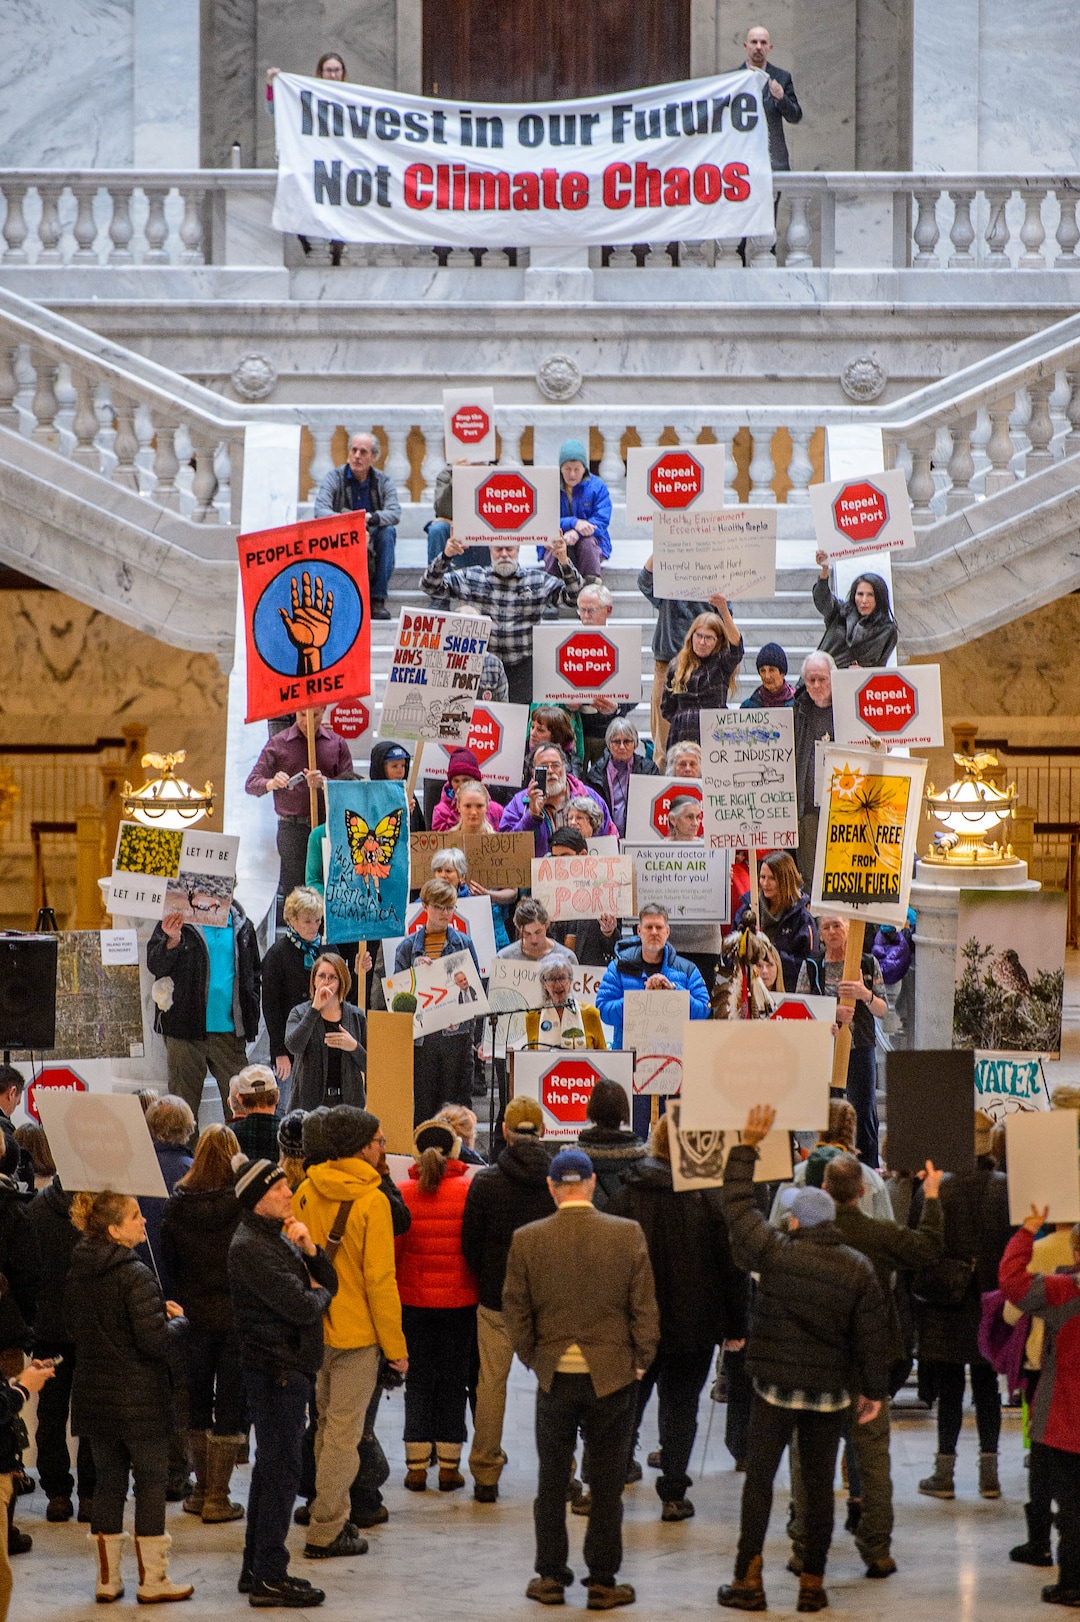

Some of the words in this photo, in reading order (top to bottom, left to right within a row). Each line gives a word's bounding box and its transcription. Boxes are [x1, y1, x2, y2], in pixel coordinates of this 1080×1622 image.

[300, 90, 448, 144] Invest
[459, 109, 504, 149] in
[518, 112, 600, 147] our
[612, 92, 759, 143] Future
[314, 159, 392, 208] Not
[404, 163, 589, 211] Climate
[603, 162, 750, 209] Chaos
[657, 465, 695, 479] Repeal
[485, 486, 527, 500] Repeal
[654, 481, 672, 493] the
[674, 480, 697, 492] Port
[482, 502, 502, 513] the
[504, 502, 530, 513] Port
[841, 494, 878, 511] Repeal
[840, 514, 858, 527] the
[860, 508, 883, 524] Port
[246, 541, 303, 569] PEOPLE
[308, 530, 360, 554] POWER
[402, 614, 446, 633] DON'T
[448, 619, 490, 639] SELL
[399, 631, 442, 650] UTAH
[566, 646, 608, 658] Repeal
[446, 653, 470, 670] TIME
[564, 660, 584, 672] the
[586, 661, 612, 672] Port
[390, 667, 428, 685] REPEAL
[432, 669, 450, 688] THE
[452, 672, 480, 690] PORT
[280, 684, 300, 702] WE
[306, 675, 344, 696] RISE
[866, 686, 907, 702] Repeal
[336, 708, 350, 716] Stop
[864, 704, 884, 716] the
[886, 704, 912, 716] Port
[334, 716, 364, 724] Polluting
[716, 712, 770, 725] WETLANDS
[468, 737, 495, 750] Port
[710, 750, 728, 764] OR
[734, 748, 794, 763] INDUSTRY
[706, 794, 728, 806] THE
[730, 792, 756, 807] RIGHT
[760, 791, 796, 804] CHOICE
[714, 808, 746, 821] CLEAR
[748, 804, 764, 820] TO
[766, 806, 791, 819] SEE
[710, 834, 749, 848] REPEAL
[748, 831, 768, 846] THE
[773, 830, 797, 847] PORT
[830, 824, 868, 843] BREAK
[876, 825, 902, 844] FREE
[410, 834, 448, 852] ROOT
[481, 834, 518, 856] ROOT
[186, 846, 200, 857] LET
[205, 849, 214, 859] IT
[218, 850, 230, 861] BE
[636, 850, 652, 858] Ask
[654, 851, 676, 862] your
[678, 850, 706, 858] doctor
[709, 850, 715, 858] if
[851, 854, 877, 868] FROM
[538, 858, 621, 882] ABORT
[645, 861, 682, 871] CLEAN
[686, 861, 706, 871] AIR
[651, 873, 672, 884] right
[674, 872, 686, 882] for
[689, 873, 709, 884] you!
[824, 872, 864, 894] FOSSIL
[866, 872, 900, 895] FUELS
[113, 888, 128, 899] LET
[136, 892, 146, 901] IT
[152, 893, 162, 904] BE
[551, 882, 619, 920] PORT
[628, 993, 682, 1017] SLC
[551, 1075, 595, 1090] Repeal
[546, 1092, 569, 1104] the
